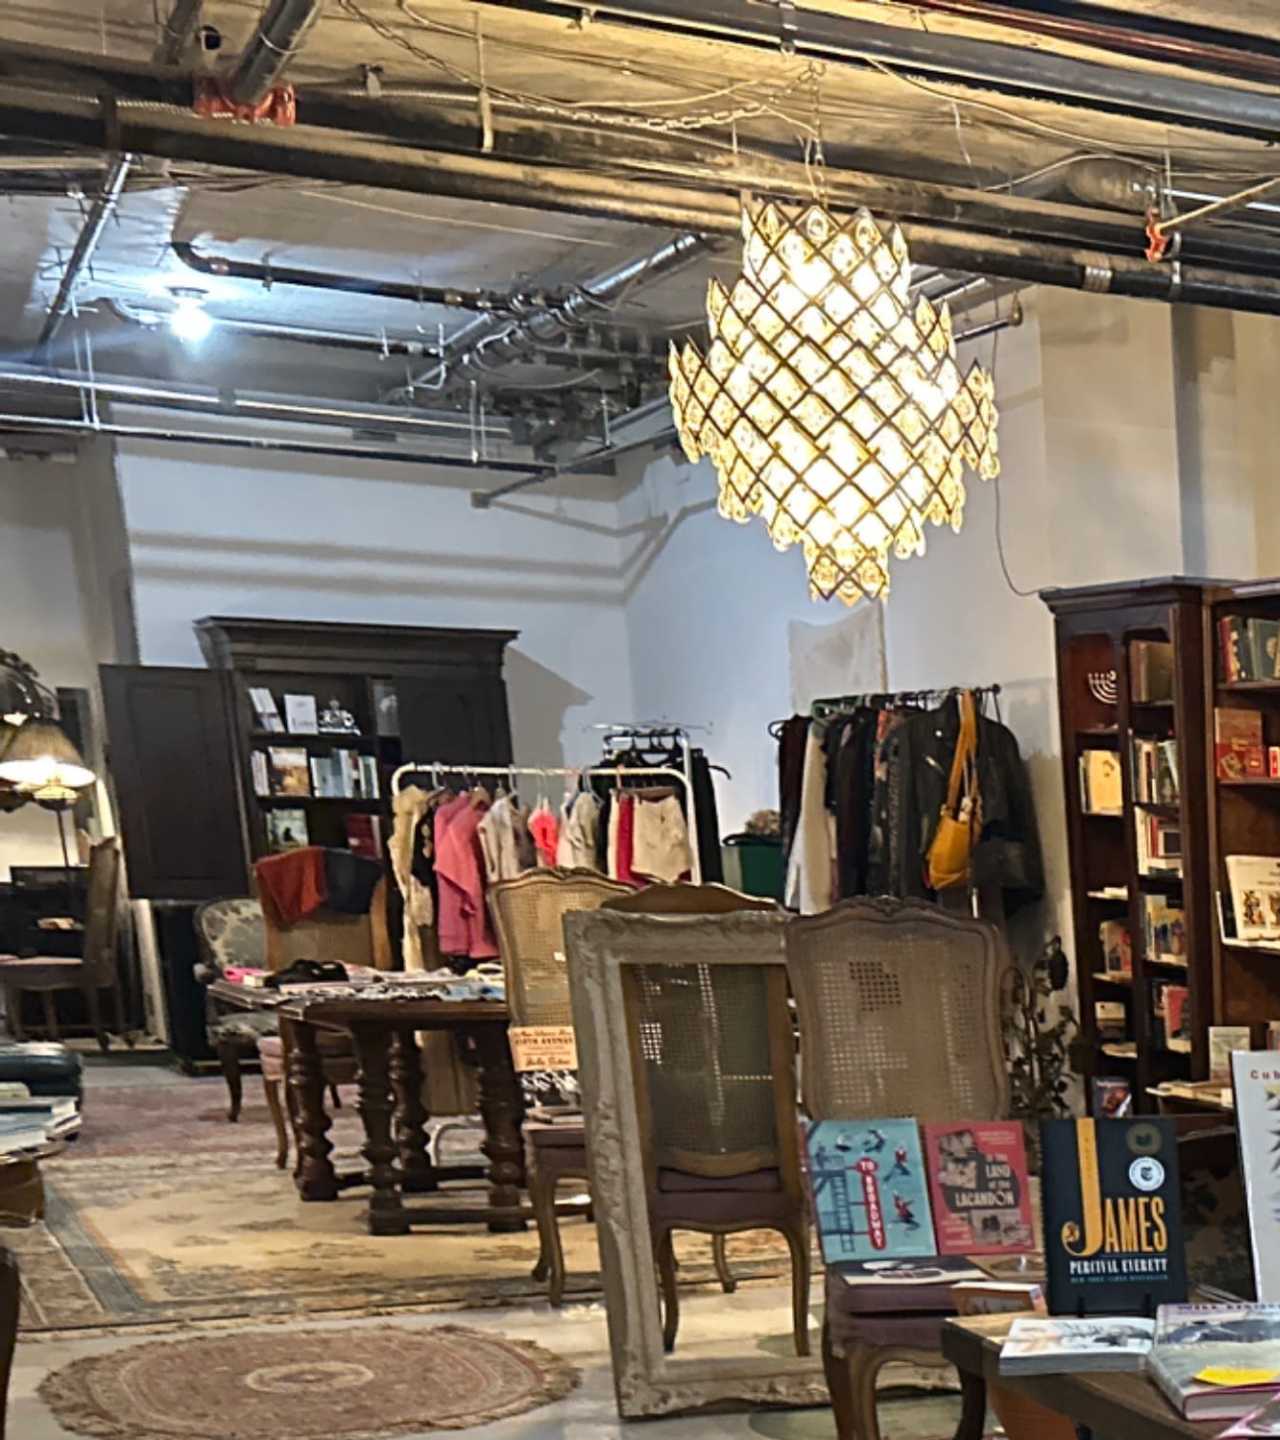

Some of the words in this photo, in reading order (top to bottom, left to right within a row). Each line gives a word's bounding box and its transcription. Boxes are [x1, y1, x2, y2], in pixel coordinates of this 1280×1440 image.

[1061, 1117, 1168, 1257] JAMES
[1070, 1259, 1120, 1275] PERCIVAL
[1122, 1257, 1168, 1273] EVERETT
